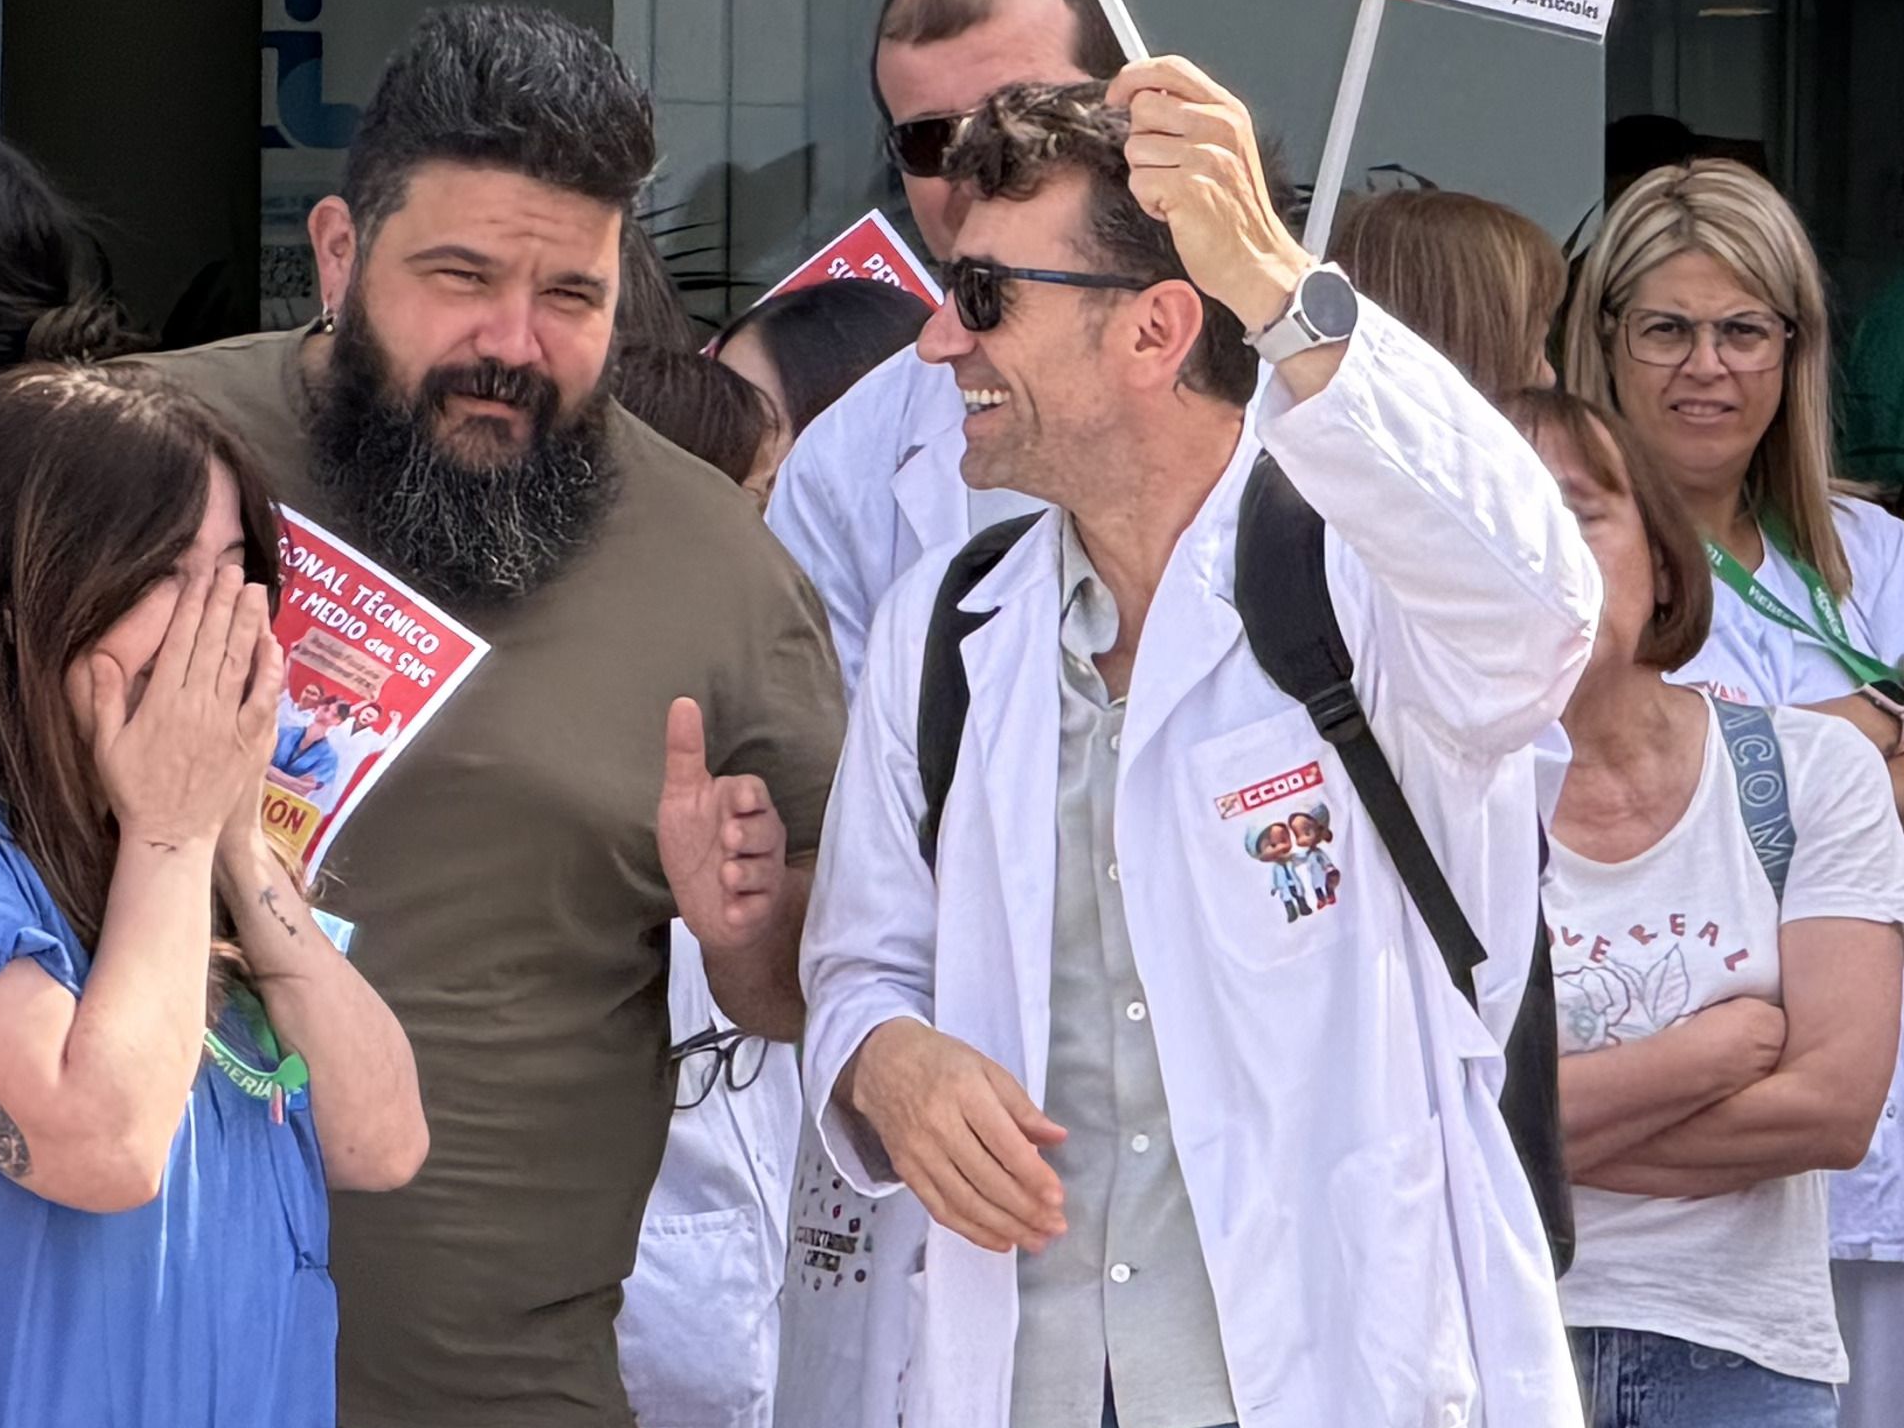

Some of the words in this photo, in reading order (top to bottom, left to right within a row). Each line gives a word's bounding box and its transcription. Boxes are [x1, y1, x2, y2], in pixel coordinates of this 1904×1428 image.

[301, 590, 367, 641] MEDIO
[395, 650, 437, 689] SNS
[350, 584, 440, 656] TÉCNICO
[1242, 772, 1305, 808] CCOO
[1627, 912, 1750, 972] REAL
